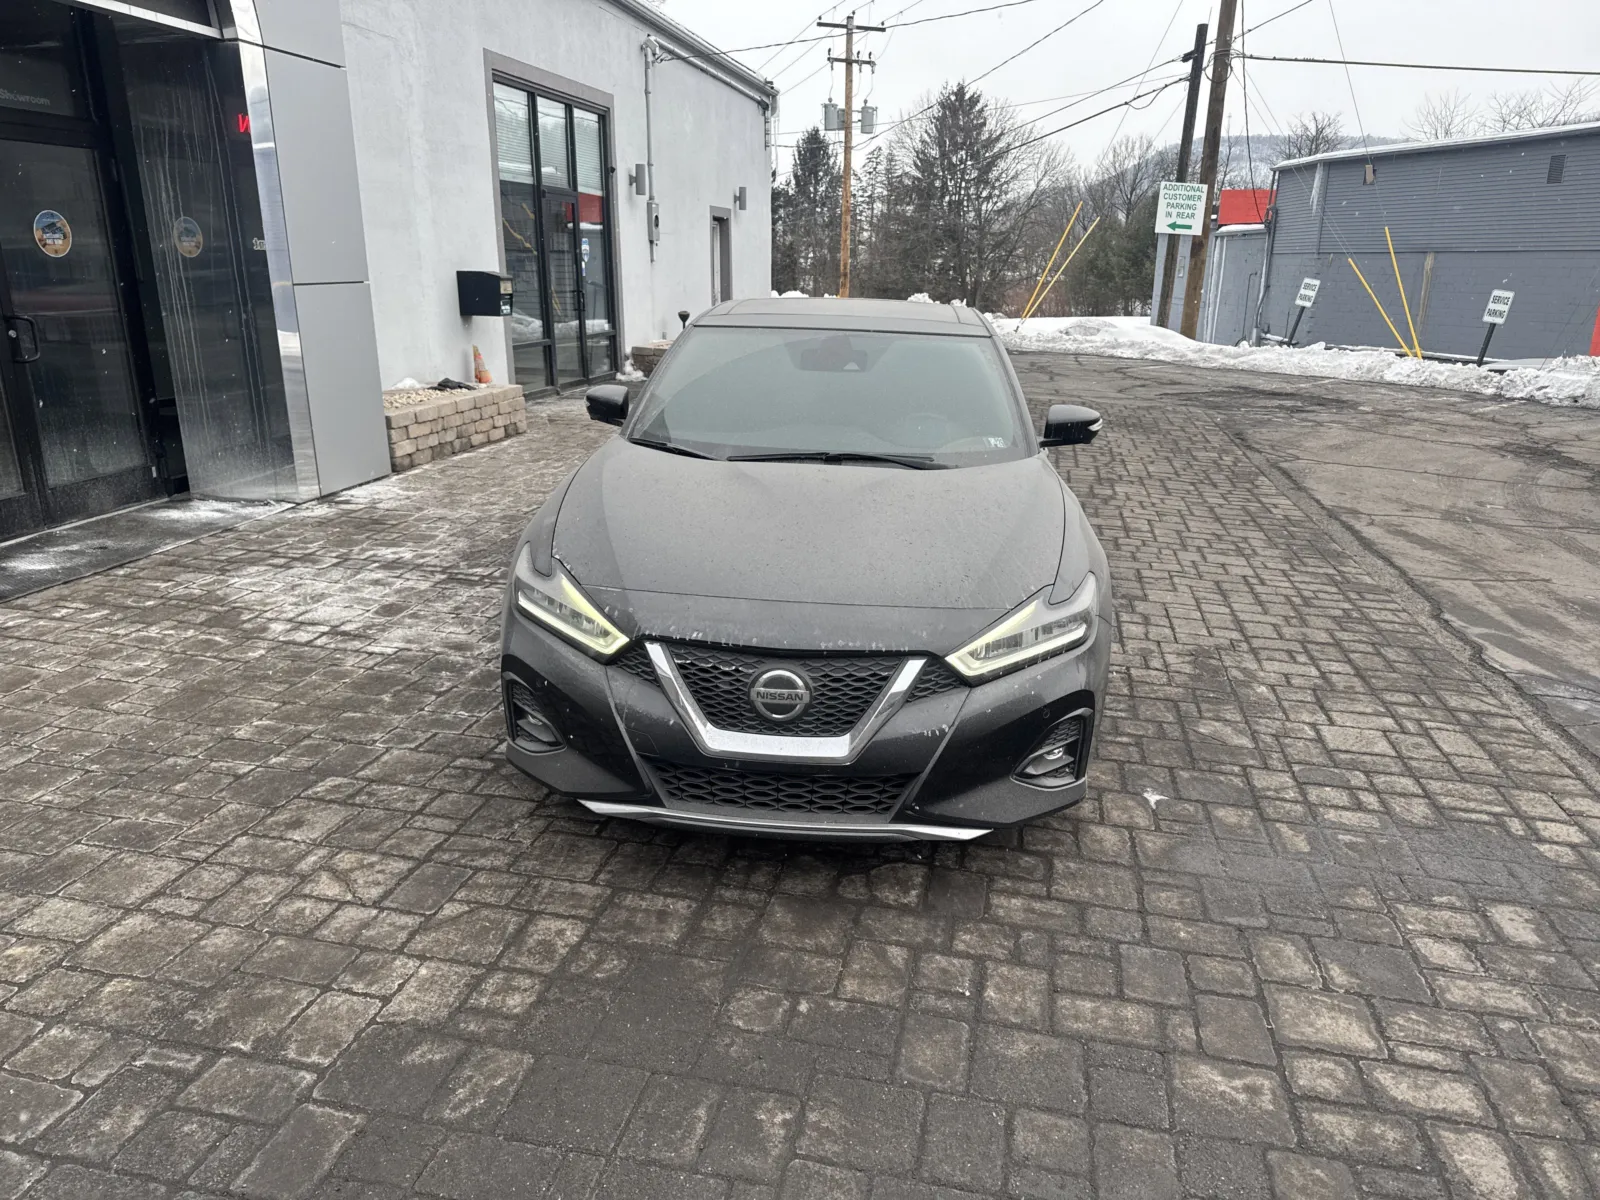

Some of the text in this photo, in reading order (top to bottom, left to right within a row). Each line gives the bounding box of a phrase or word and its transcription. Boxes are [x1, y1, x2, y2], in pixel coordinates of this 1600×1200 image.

[1163, 184, 1204, 193] ADDITIONAL
[1163, 192, 1202, 202] CUSTOMER
[1166, 202, 1197, 211] PARKING
[1165, 210, 1196, 220] IN REAR
[1302, 282, 1318, 292] SERVICE
[1298, 293, 1314, 303] PARKING
[1491, 295, 1510, 305] SERVICE
[1486, 308, 1506, 319] PARKING
[756, 691, 803, 701] NISSAN
